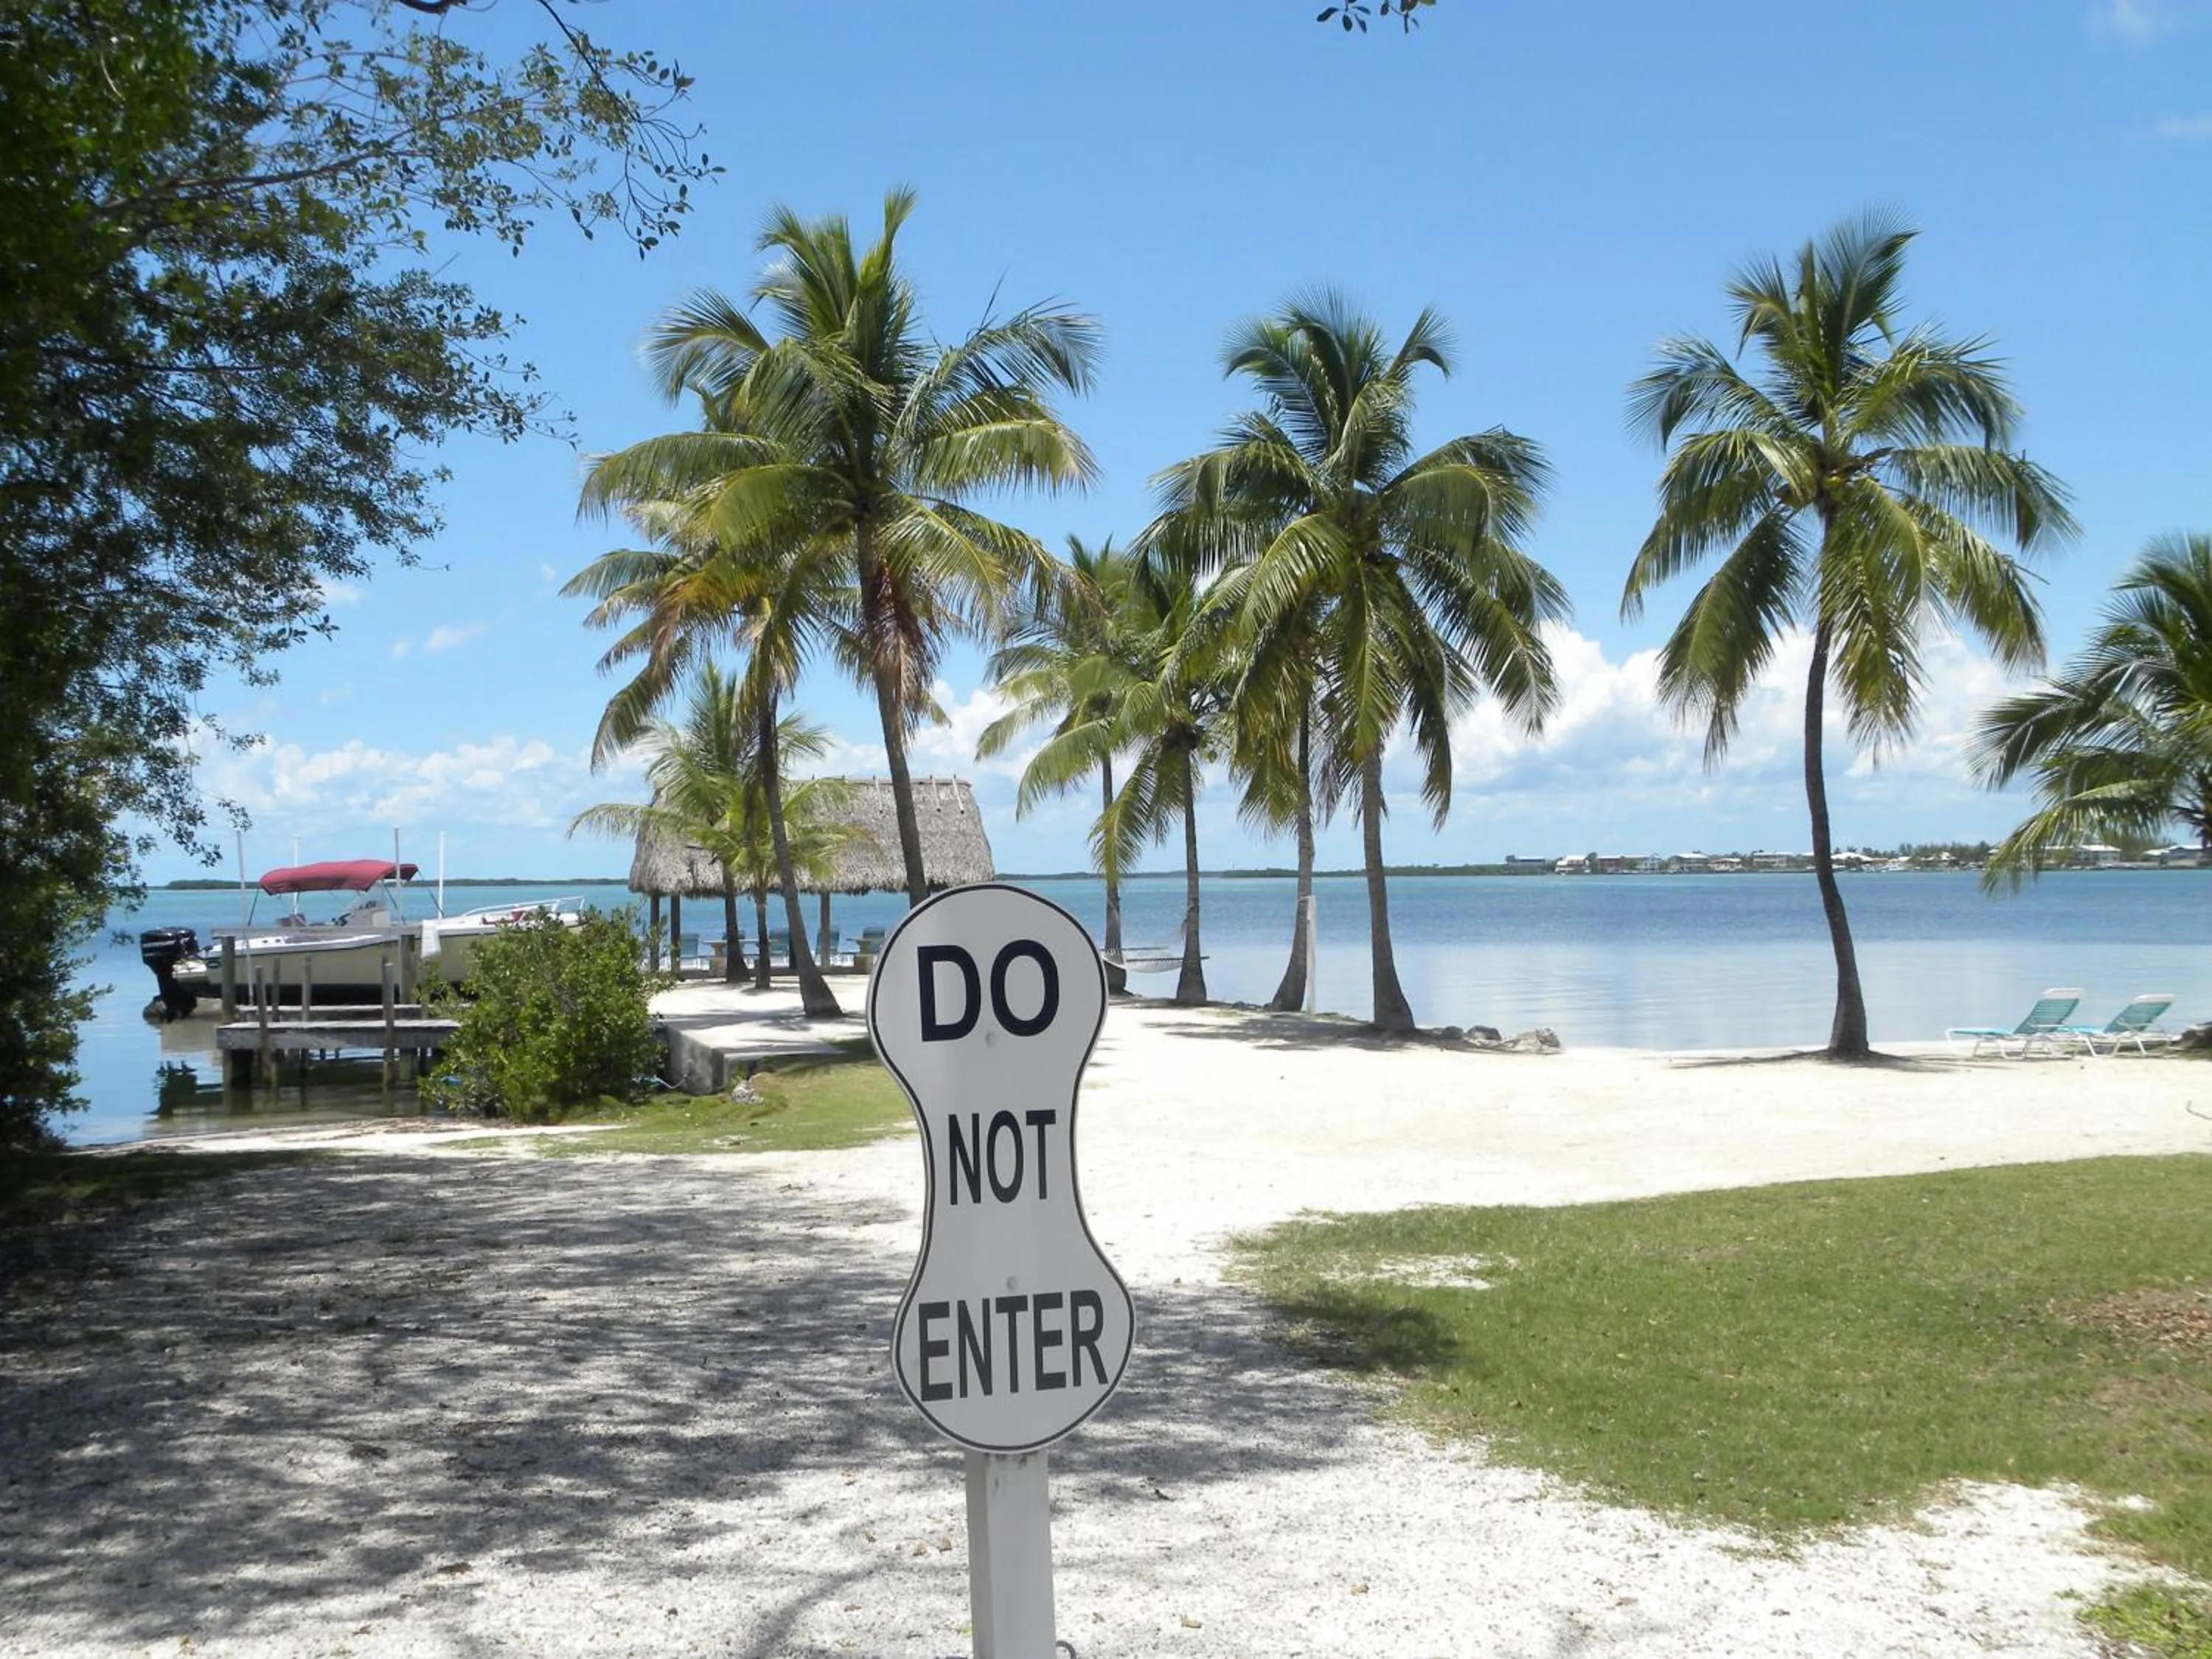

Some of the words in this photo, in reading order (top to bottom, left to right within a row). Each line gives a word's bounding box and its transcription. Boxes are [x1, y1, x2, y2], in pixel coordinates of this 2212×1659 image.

[917, 939, 1060, 1042] DO
[948, 1108, 1057, 1206] NOT
[918, 1289, 1109, 1402] ENTER
